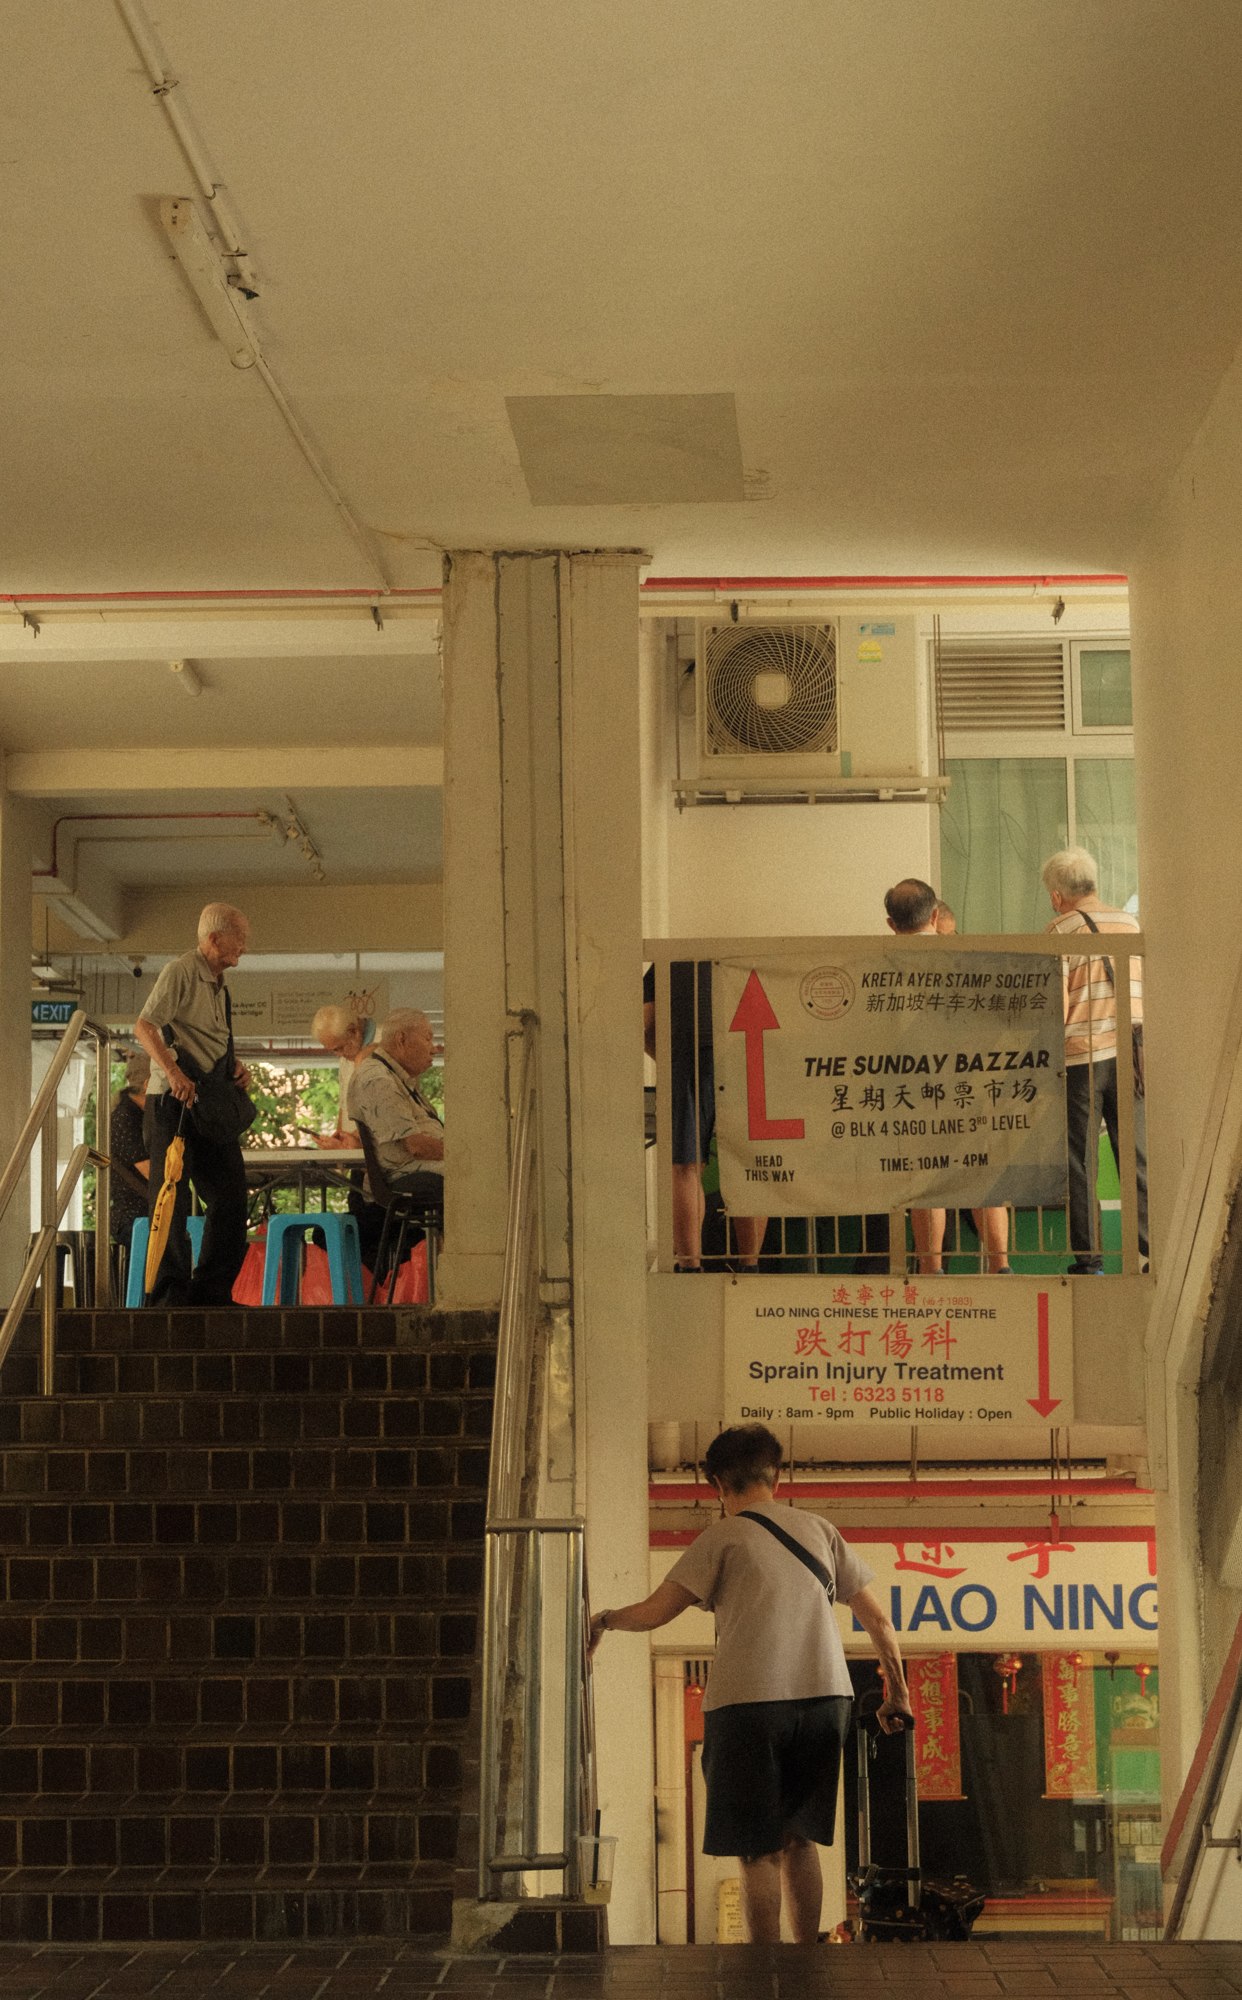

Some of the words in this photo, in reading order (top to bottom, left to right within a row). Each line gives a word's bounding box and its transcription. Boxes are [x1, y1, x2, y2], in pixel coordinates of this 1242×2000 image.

[861, 972, 903, 988] KRETA
[907, 972, 942, 988] AYER
[945, 973, 992, 988] STAMP
[995, 972, 1051, 989] SOCIETY
[865, 992, 1048, 1012] 新加坡牛车水集邮会
[40, 1004, 71, 1021] EXIT
[804, 1057, 847, 1077] THE
[852, 1054, 949, 1076] SUNDAY
[954, 1050, 1050, 1073] BAZZAR
[830, 1078, 1038, 1112] 星期天邮票市场
[831, 1121, 845, 1138] @
[850, 1121, 875, 1137] BLK
[880, 1121, 888, 1136] 4
[893, 1120, 927, 1136] SAGO
[931, 1118, 965, 1135] LANE
[991, 1114, 1031, 1131] LEVEL
[755, 1155, 783, 1167] HEAD
[880, 1157, 914, 1172] TIME:
[917, 1155, 949, 1170] 10AM
[962, 1153, 989, 1167] 4PM
[745, 1169, 769, 1182] THIS
[771, 1170, 795, 1182] WAY
[755, 1307, 785, 1318] LIAO
[789, 1307, 820, 1318] NING
[823, 1307, 879, 1319] CHINESE
[882, 1308, 941, 1319] THERAPY
[945, 1308, 997, 1319] CENTRE
[793, 1319, 958, 1361] 跌打傷科
[749, 1362, 819, 1383] Sprain
[826, 1362, 887, 1384] Injury
[893, 1363, 1004, 1381] Treatment
[808, 1386, 836, 1402] Tel
[853, 1387, 896, 1402] 6323
[902, 1387, 945, 1402] 5118
[741, 1406, 774, 1420] Daily
[786, 1407, 814, 1418] 8am
[825, 1407, 854, 1421] 9pm
[869, 1407, 911, 1419] Public
[915, 1408, 965, 1421] Holiday
[976, 1408, 1012, 1422] Open
[1024, 1582, 1159, 1632] NING
[919, 1659, 949, 1762] 心想事成
